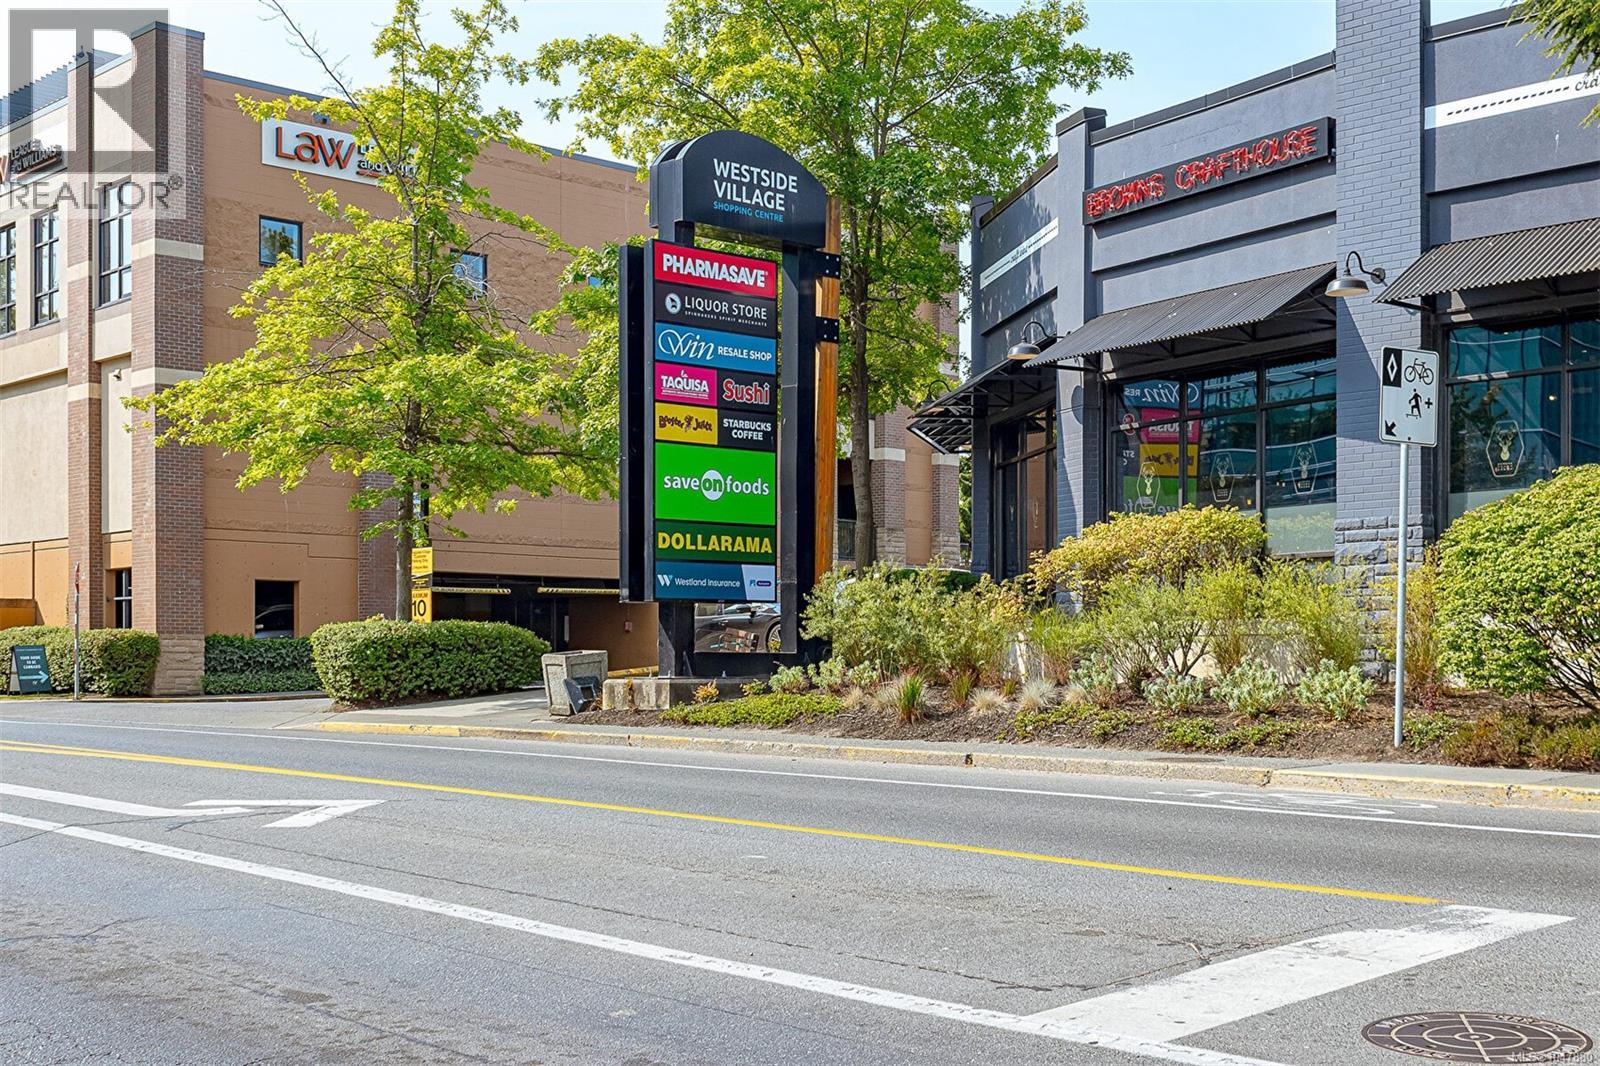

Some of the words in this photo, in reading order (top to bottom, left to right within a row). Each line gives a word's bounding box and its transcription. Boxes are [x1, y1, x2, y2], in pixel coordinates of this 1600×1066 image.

[276, 126, 354, 169] Law
[713, 158, 798, 193] WESTSIDE
[1086, 172, 1165, 217] BROWNS
[1175, 125, 1318, 190] CRAFTHOUSE
[713, 179, 785, 211] VILLAGE
[713, 201, 753, 216] SHOPPING
[754, 209, 784, 222] CENTRE
[684, 295, 729, 314] LIQUOR
[732, 303, 767, 320] STORE
[658, 329, 715, 361] Win
[717, 345, 748, 359] RESALE
[749, 350, 772, 362] SHOP
[661, 375, 709, 392] TAQUISA
[722, 378, 770, 405] Sushi
[722, 418, 772, 431] STARBUCKS
[731, 429, 764, 440] COFFEE
[663, 475, 700, 490] save
[702, 477, 723, 492] on
[725, 476, 769, 495] foods
[658, 532, 772, 553] DOLLARAMA
[674, 577, 707, 587] Westland
[707, 579, 741, 588] Insurance
[412, 599, 427, 617] 10
